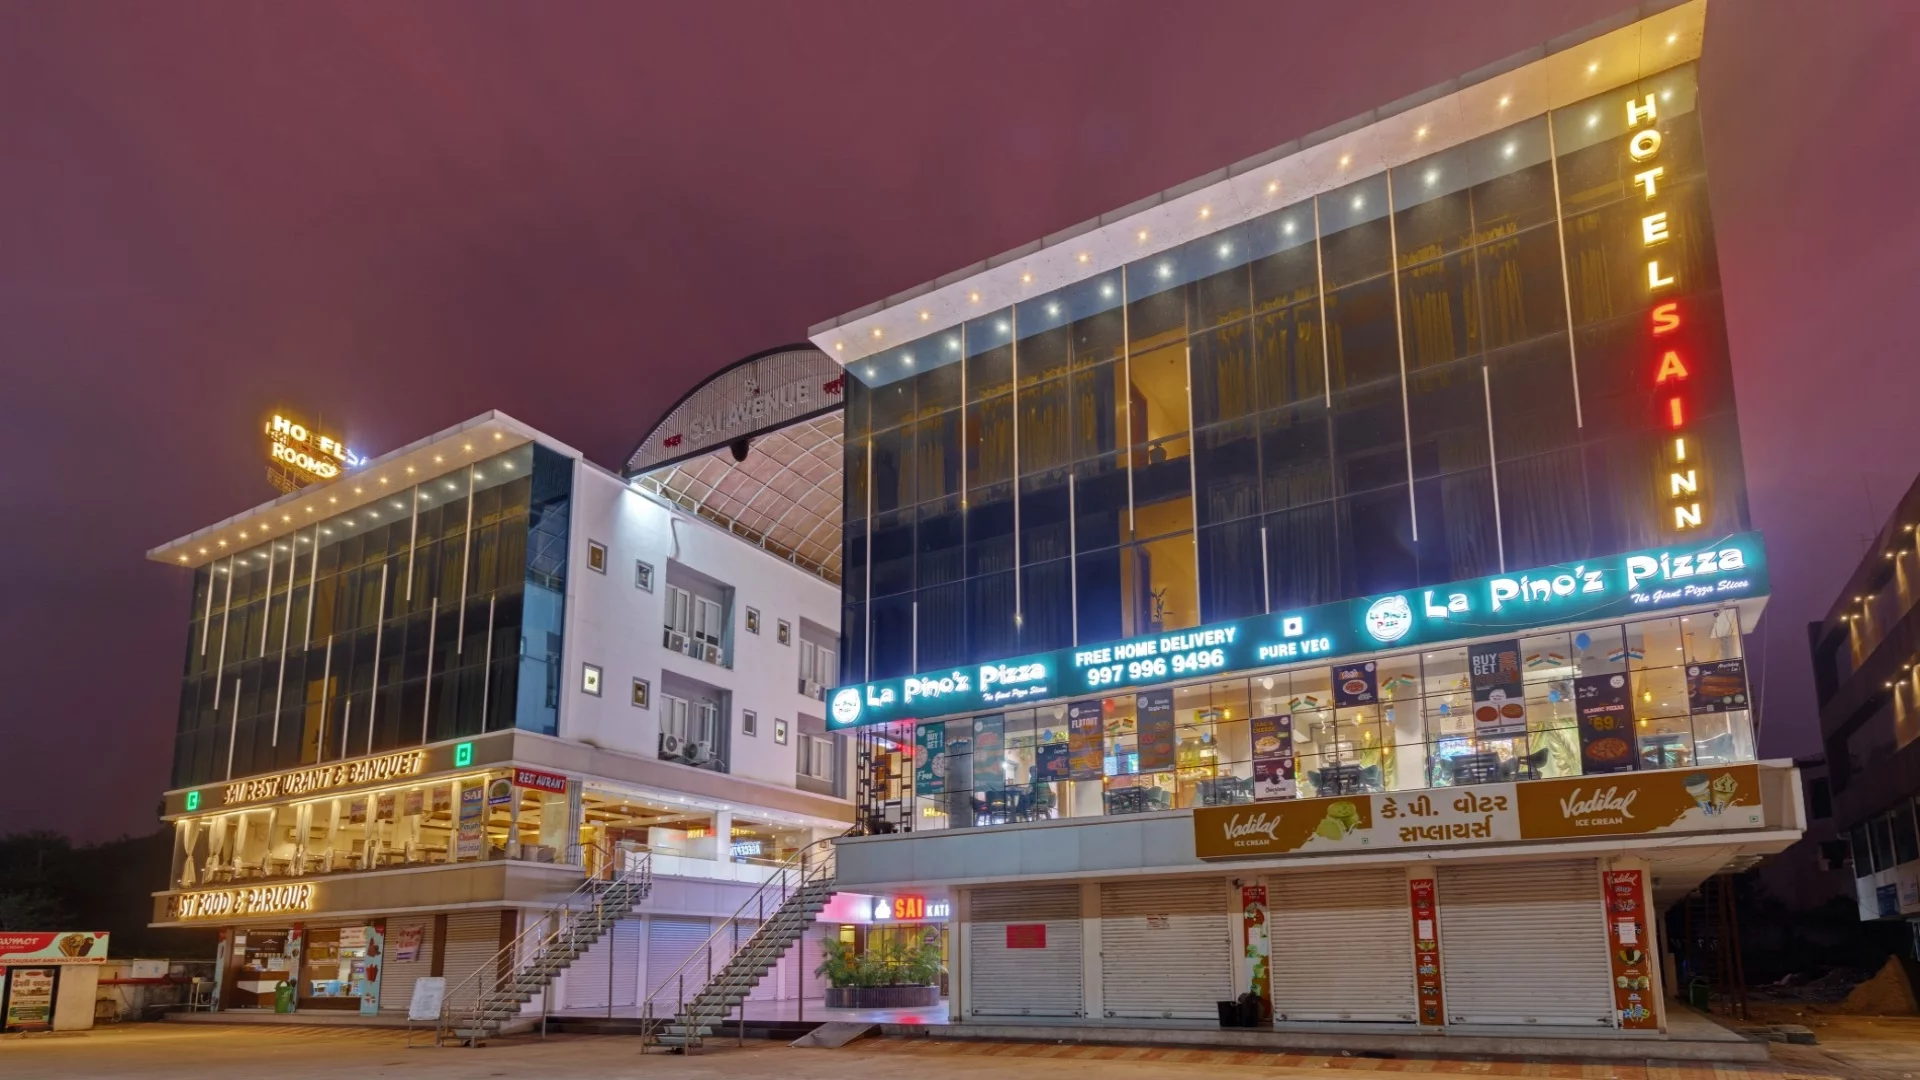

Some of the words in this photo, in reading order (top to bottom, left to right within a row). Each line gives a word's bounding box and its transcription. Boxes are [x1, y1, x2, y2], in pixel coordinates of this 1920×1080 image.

[1626, 93, 1675, 292] HOTEL
[1652, 302, 1689, 427] SAI
[1671, 438, 1702, 531] INN
[690, 409, 726, 440] SAI
[727, 379, 810, 426] AVENUE
[1424, 590, 1470, 618] La
[1490, 565, 1605, 612] Pino'z
[1626, 548, 1746, 592] Pizza
[1631, 593, 1650, 603] The
[1652, 589, 1682, 603] Giant
[1684, 585, 1714, 597] Pizza
[1717, 580, 1749, 591] Slices
[1075, 648, 1111, 667] FREE
[1115, 642, 1157, 662] HOME
[1160, 627, 1236, 652] DELIVERY
[1259, 642, 1296, 660] PURE
[1301, 638, 1330, 652] VEG
[1472, 653, 1497, 666] BUY
[1087, 665, 1123, 686] 997
[1128, 659, 1166, 679] 996
[1172, 649, 1224, 674] 9496
[1473, 663, 1496, 675] GET
[867, 686, 894, 707] La
[905, 671, 969, 703] Pino'z
[980, 663, 1046, 692] Pizza
[224, 782, 246, 804] SAI
[247, 767, 331, 799] RESTAURANT
[333, 765, 344, 785] &
[348, 751, 422, 783] BANQUET
[463, 790, 482, 800] SAI
[1453, 791, 1508, 813] વોટર
[1560, 786, 1638, 819] Vadilal
[1223, 812, 1280, 841] Vadilal
[1399, 814, 1493, 841] સપ્લાયર્સ
[1575, 819, 1590, 827] ICE
[1591, 817, 1623, 826] CREAM
[1249, 839, 1270, 847] CREAM
[198, 891, 231, 916] FOOD
[234, 890, 245, 914] &
[248, 884, 313, 913] PARLOUR
[895, 898, 922, 918] SAI
